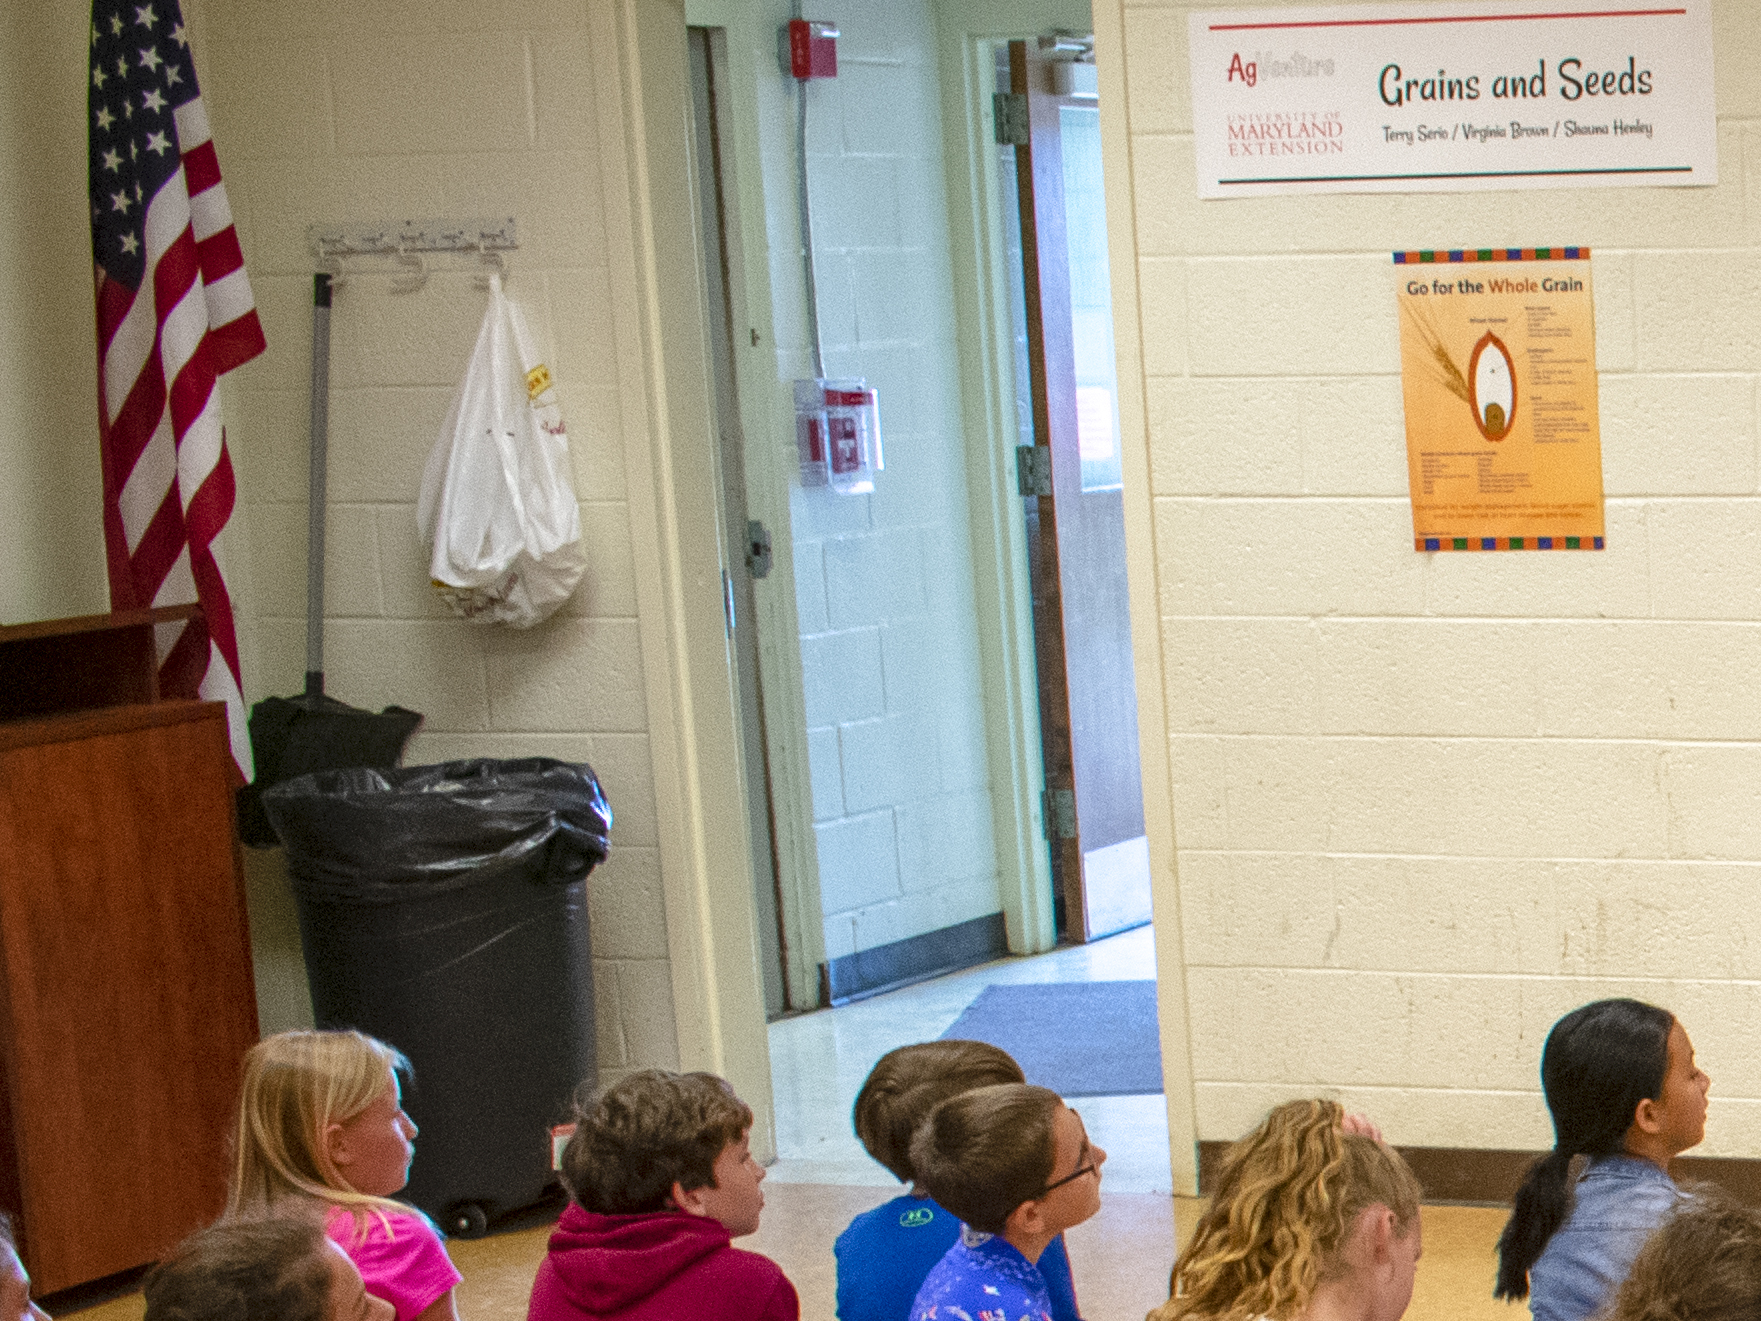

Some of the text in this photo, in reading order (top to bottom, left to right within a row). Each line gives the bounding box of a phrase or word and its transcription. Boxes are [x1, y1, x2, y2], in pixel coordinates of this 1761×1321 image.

[1378, 56, 1654, 107] Grains and Seeds
[1227, 111, 1318, 122] UNIVERSITY
[1227, 121, 1343, 140] MARYLAND
[1381, 125, 1414, 145] Terry
[1461, 122, 1507, 143] Virginia
[1509, 120, 1549, 139] Brown
[1228, 141, 1343, 157] EXTENSION
[1407, 277, 1583, 295] Go for the Whole Grain
